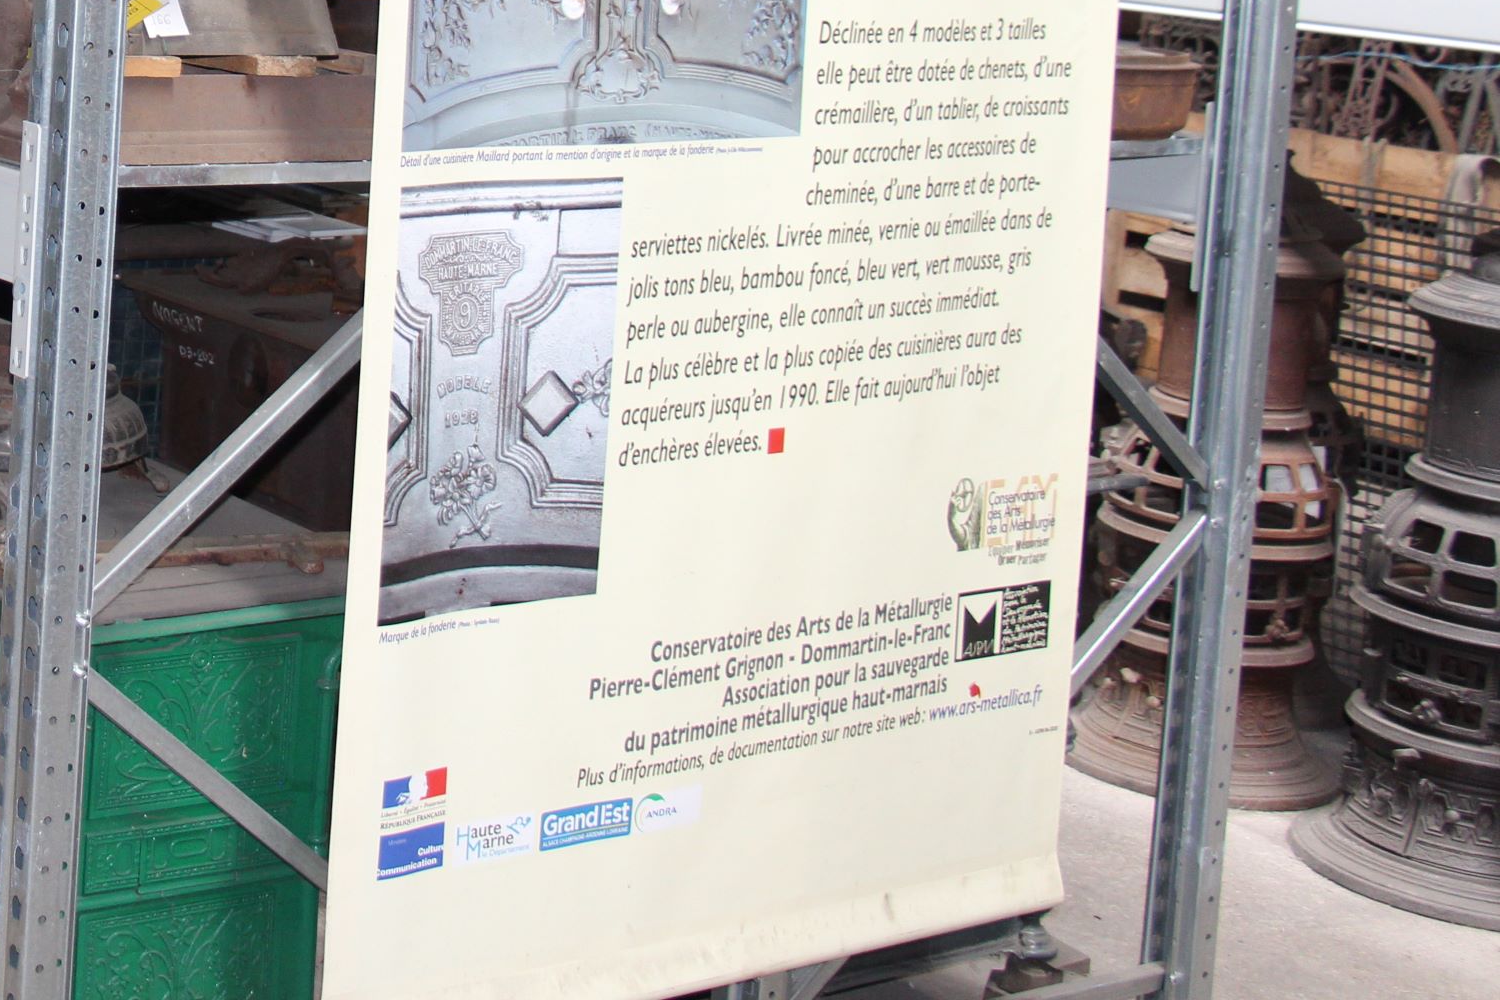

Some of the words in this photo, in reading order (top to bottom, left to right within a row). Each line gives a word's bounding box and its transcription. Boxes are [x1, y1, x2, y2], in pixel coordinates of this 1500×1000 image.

[152, 300, 204, 333] NOGENT
[460, 301, 471, 328] 9
[621, 400, 706, 431] acquéreurs
[708, 388, 772, 423] jusqu'en
[780, 382, 819, 409] 1990.
[825, 379, 850, 404] Elle
[854, 376, 880, 406] fait
[883, 367, 957, 402] aujourd'hui
[960, 364, 1001, 391] l'objet
[618, 437, 700, 467] d'enchères
[704, 429, 762, 457] élevées.
[987, 505, 1001, 520] des
[1004, 504, 1021, 518] Arts
[988, 486, 1046, 506] Conservatoire
[378, 631, 410, 645] Marque
[410, 629, 420, 639] de
[420, 626, 427, 636] la
[427, 620, 457, 637] fonderie
[650, 627, 763, 663] Conservatoire
[766, 621, 792, 643] des
[795, 615, 831, 638] Arts
[835, 610, 854, 632] de
[857, 607, 870, 628] la
[874, 596, 953, 625] Métallurgie
[589, 663, 721, 700] Pierre-Clément
[725, 652, 784, 682] Grignon
[800, 622, 951, 665] Dommartin-le-Franc
[721, 674, 810, 708] Association
[814, 669, 851, 697] pour
[854, 662, 867, 683] la
[871, 646, 949, 680] sauvegarde
[624, 730, 646, 753] du
[650, 716, 738, 756] patrimoine
[741, 697, 848, 731] métallurgique
[851, 674, 948, 711] haut-marnais
[577, 767, 605, 789] Plus
[608, 754, 705, 785] d'informations,
[709, 745, 724, 766] de
[727, 730, 818, 761] documentation
[820, 727, 840, 744] sur
[842, 721, 873, 739] notre
[875, 716, 896, 733] site
[899, 706, 926, 727] web:
[929, 683, 1043, 721] www.ars-metallica.fr
[645, 805, 678, 819] ANDRA
[456, 824, 502, 846] Haute
[465, 833, 514, 861] Marne
